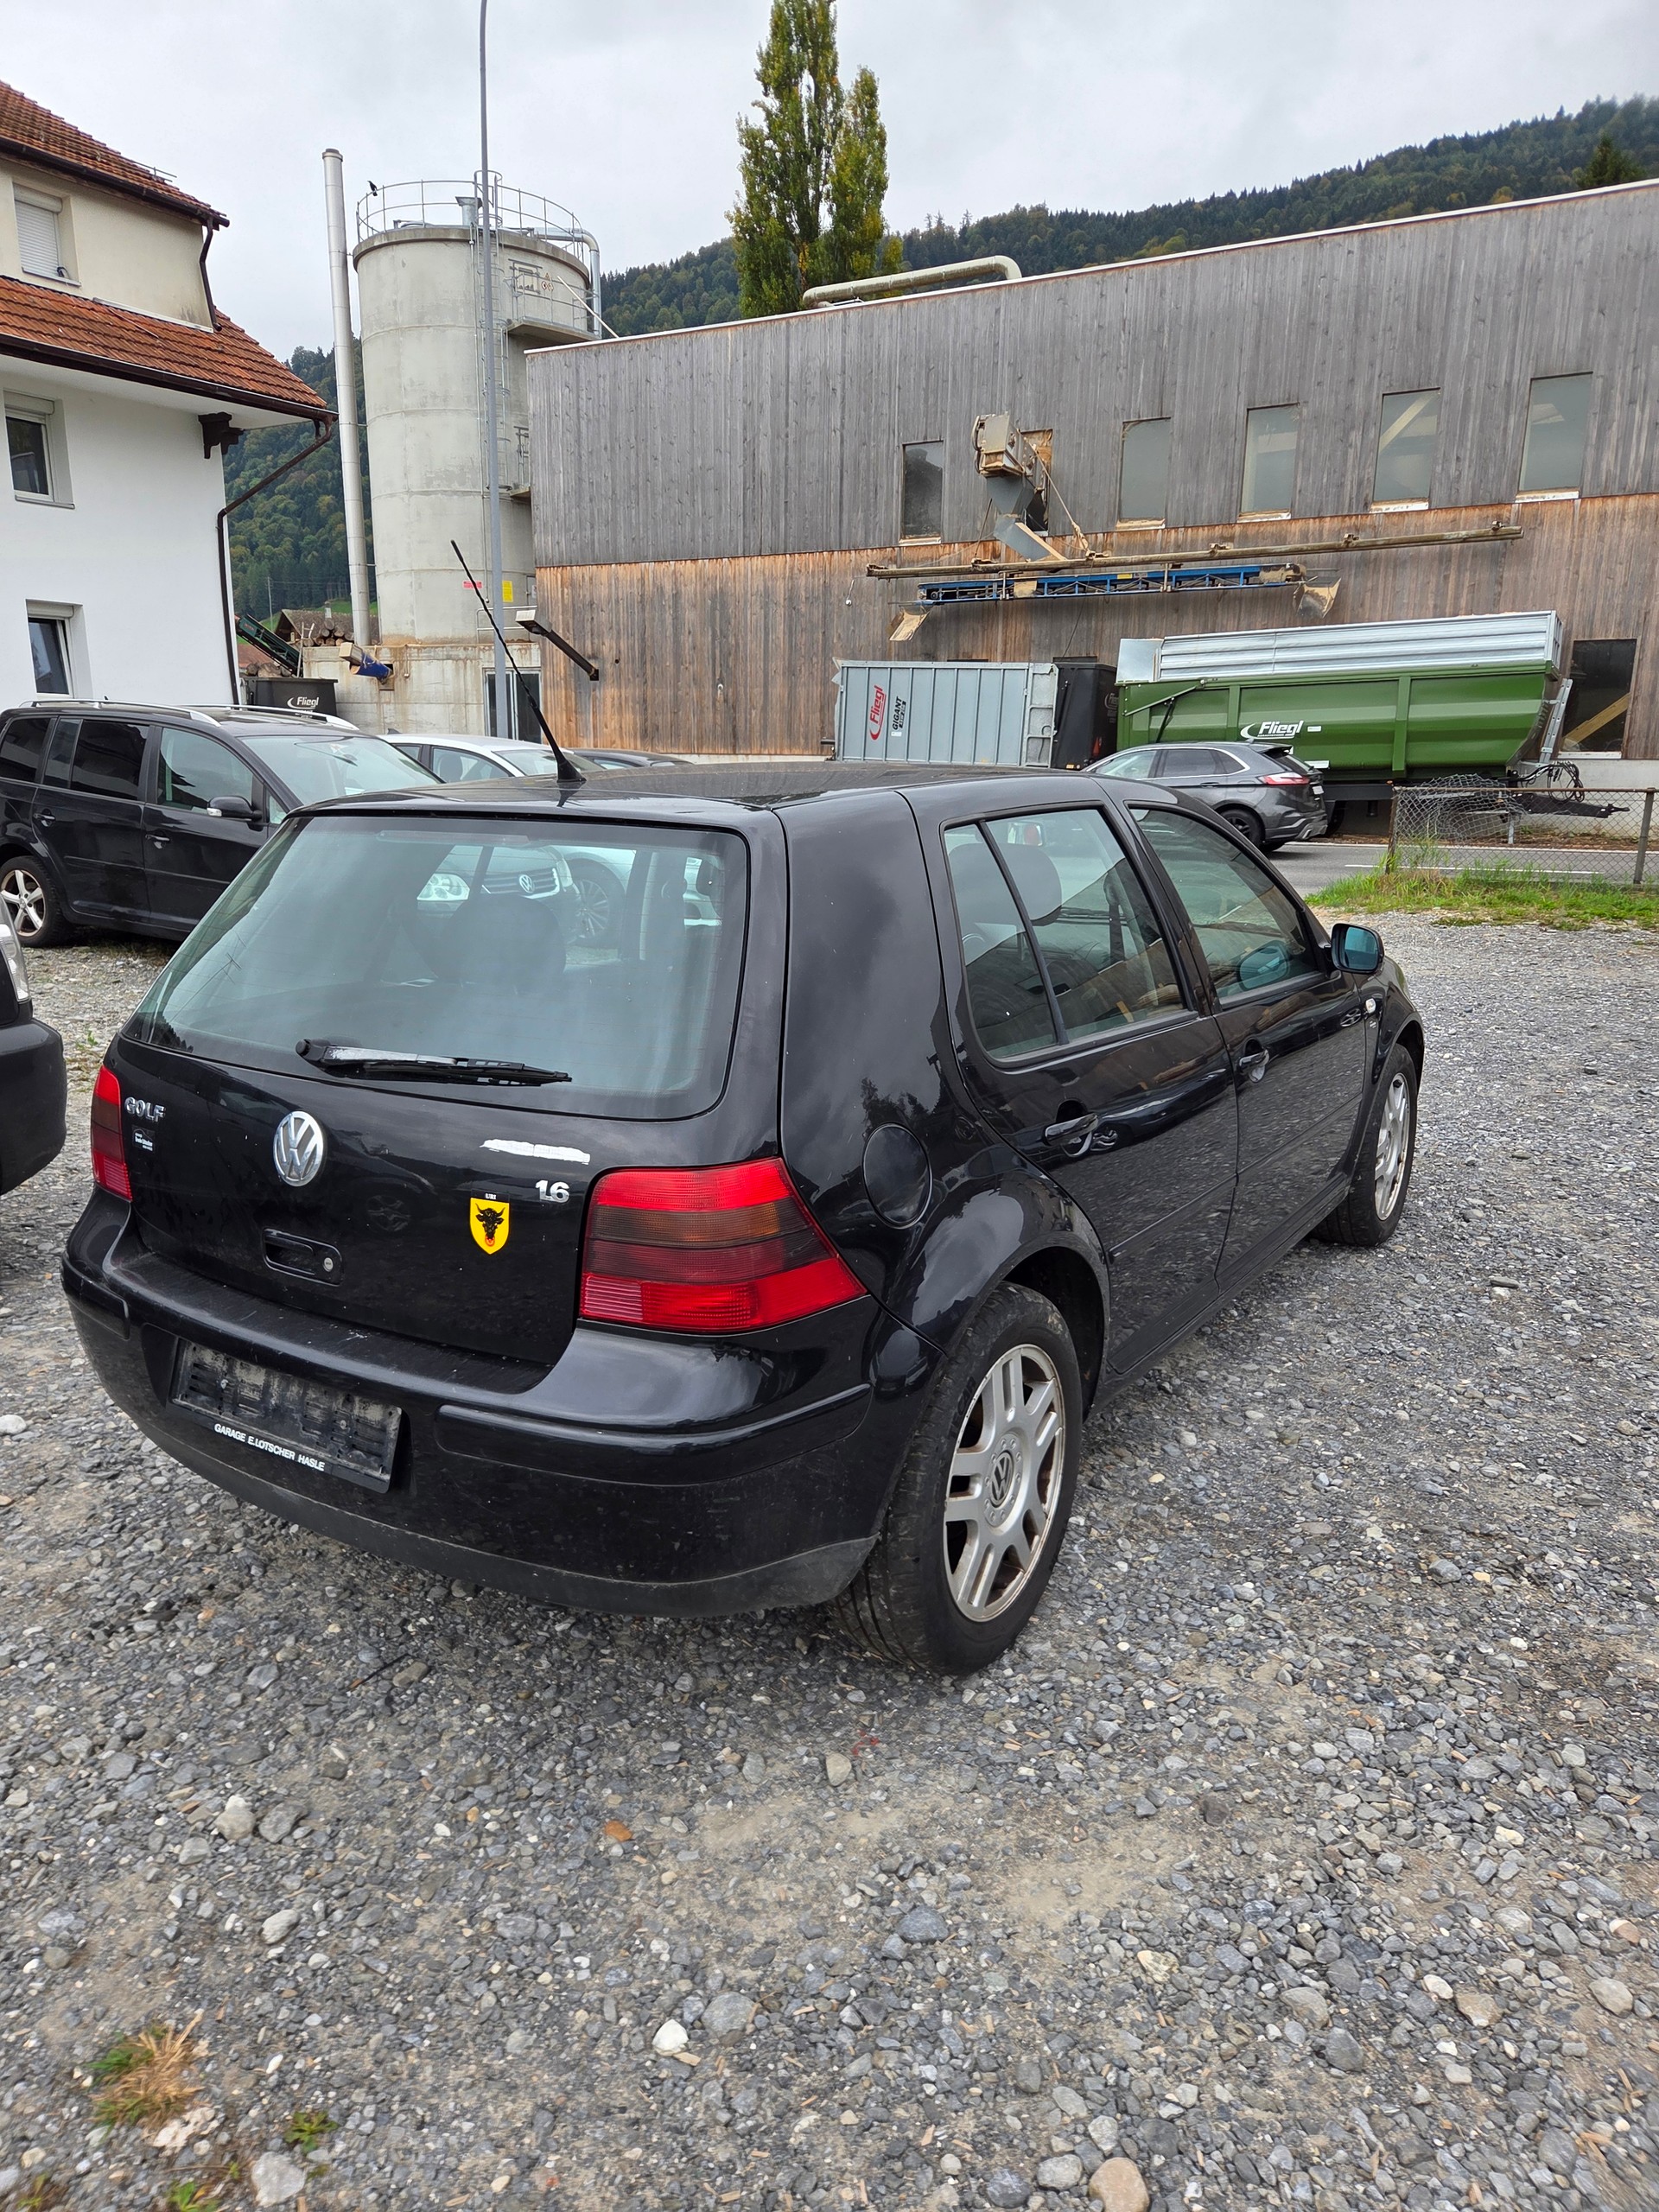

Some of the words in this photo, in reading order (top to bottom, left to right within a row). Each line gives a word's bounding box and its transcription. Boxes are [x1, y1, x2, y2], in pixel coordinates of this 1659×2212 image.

[296, 696, 320, 708] Fliegl
[869, 684, 886, 724] Fliegl
[892, 696, 902, 730] GIGANT
[1259, 720, 1304, 736] Fliegl
[124, 1096, 166, 1122] GOLF
[272, 1110, 324, 1187] VW
[213, 1423, 247, 1443] GARAGE
[297, 1453, 326, 1471] HASLE
